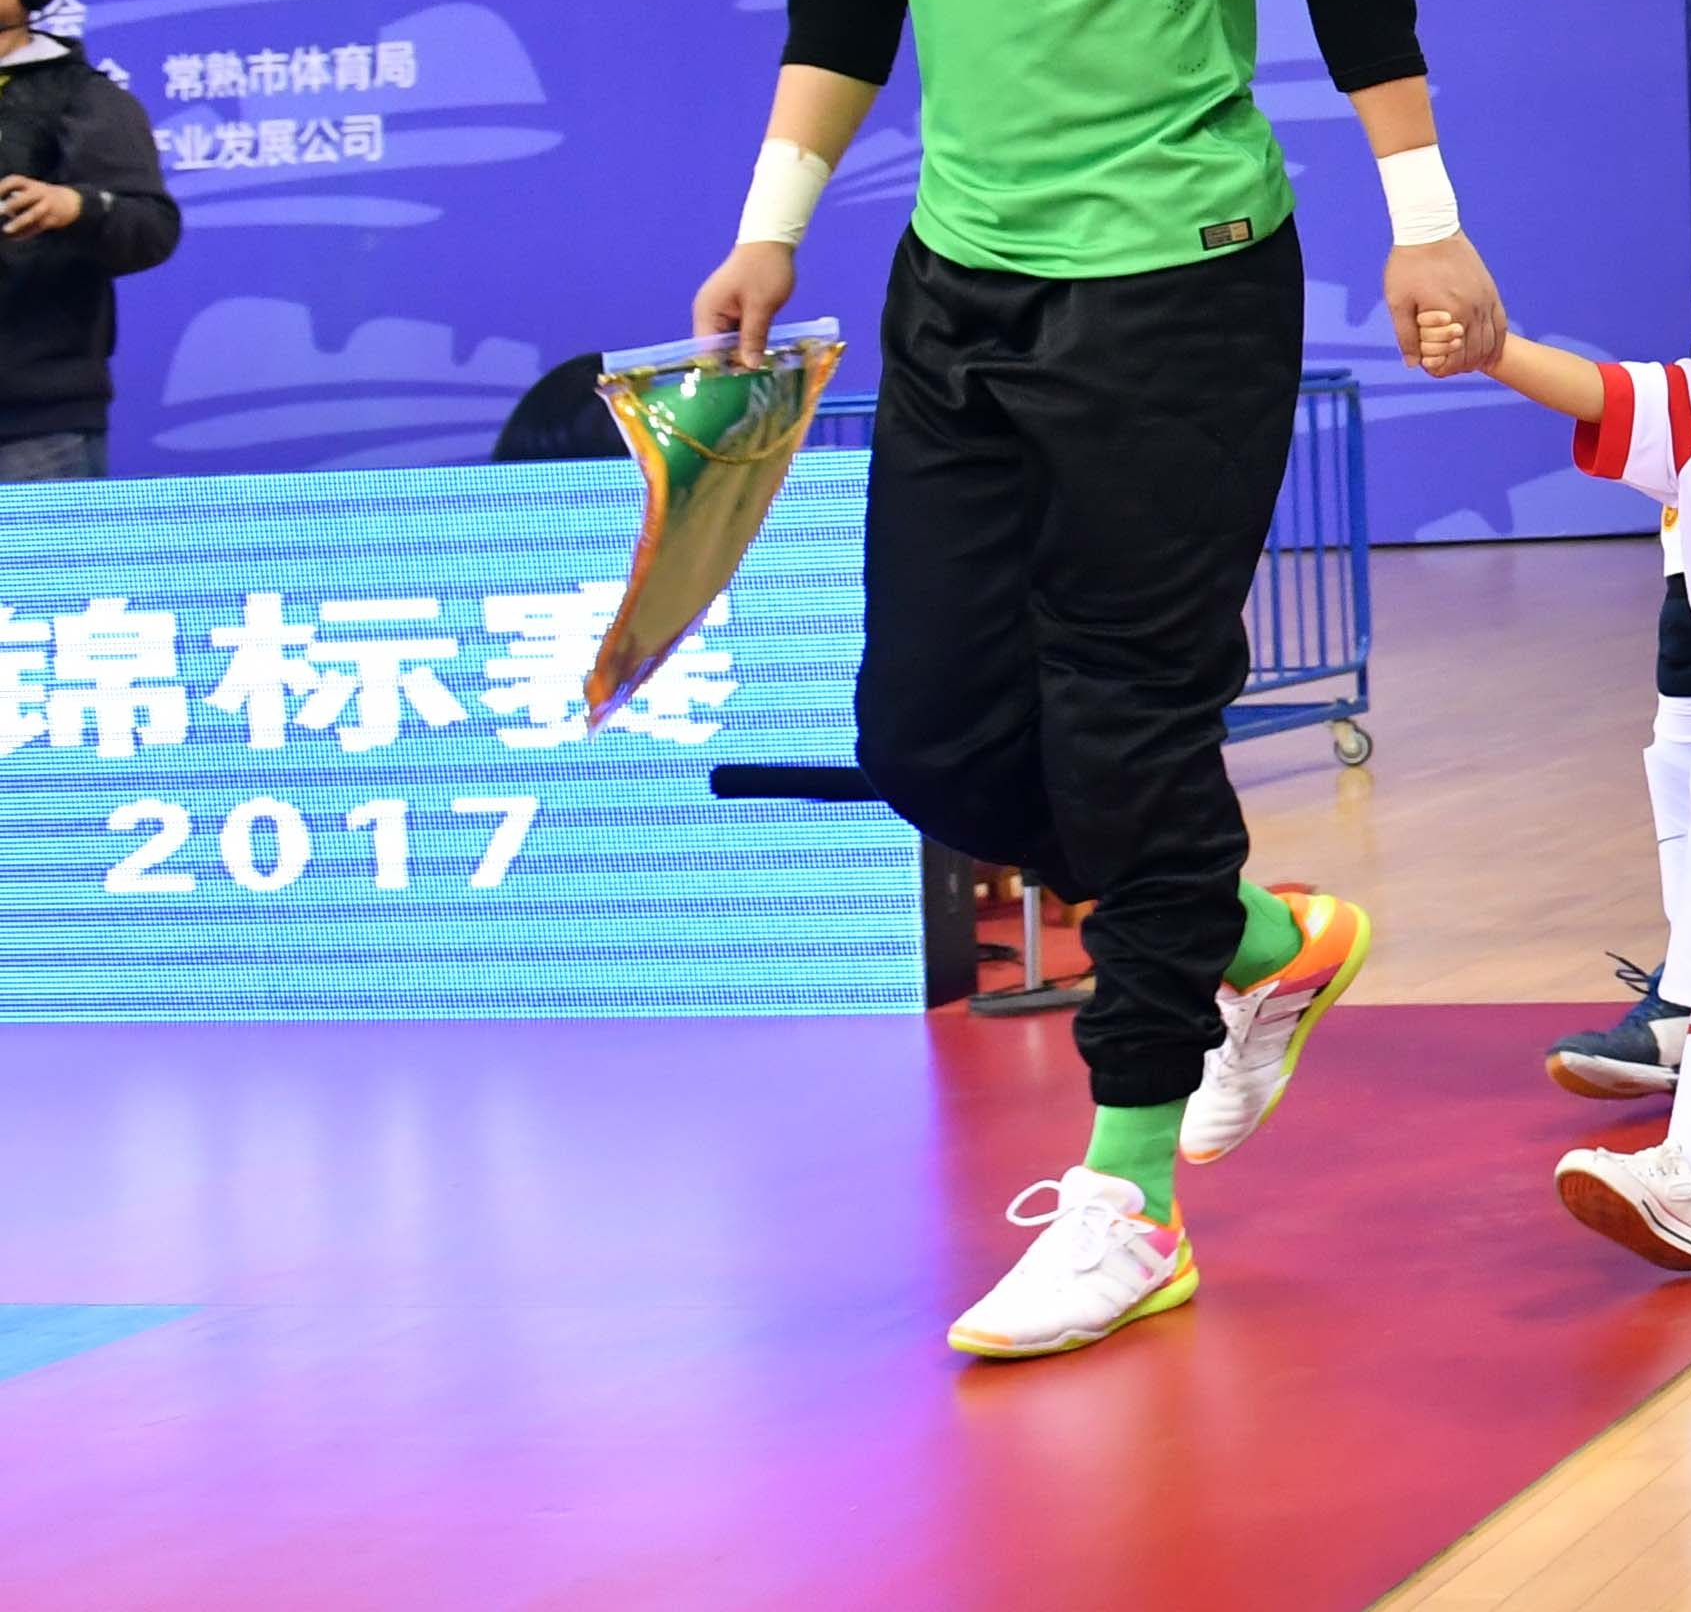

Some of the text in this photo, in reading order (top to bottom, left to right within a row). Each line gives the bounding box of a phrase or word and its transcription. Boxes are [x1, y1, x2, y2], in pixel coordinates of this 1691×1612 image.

[164, 41, 417, 102] 常熟市体育局
[103, 796, 542, 895] 2017
